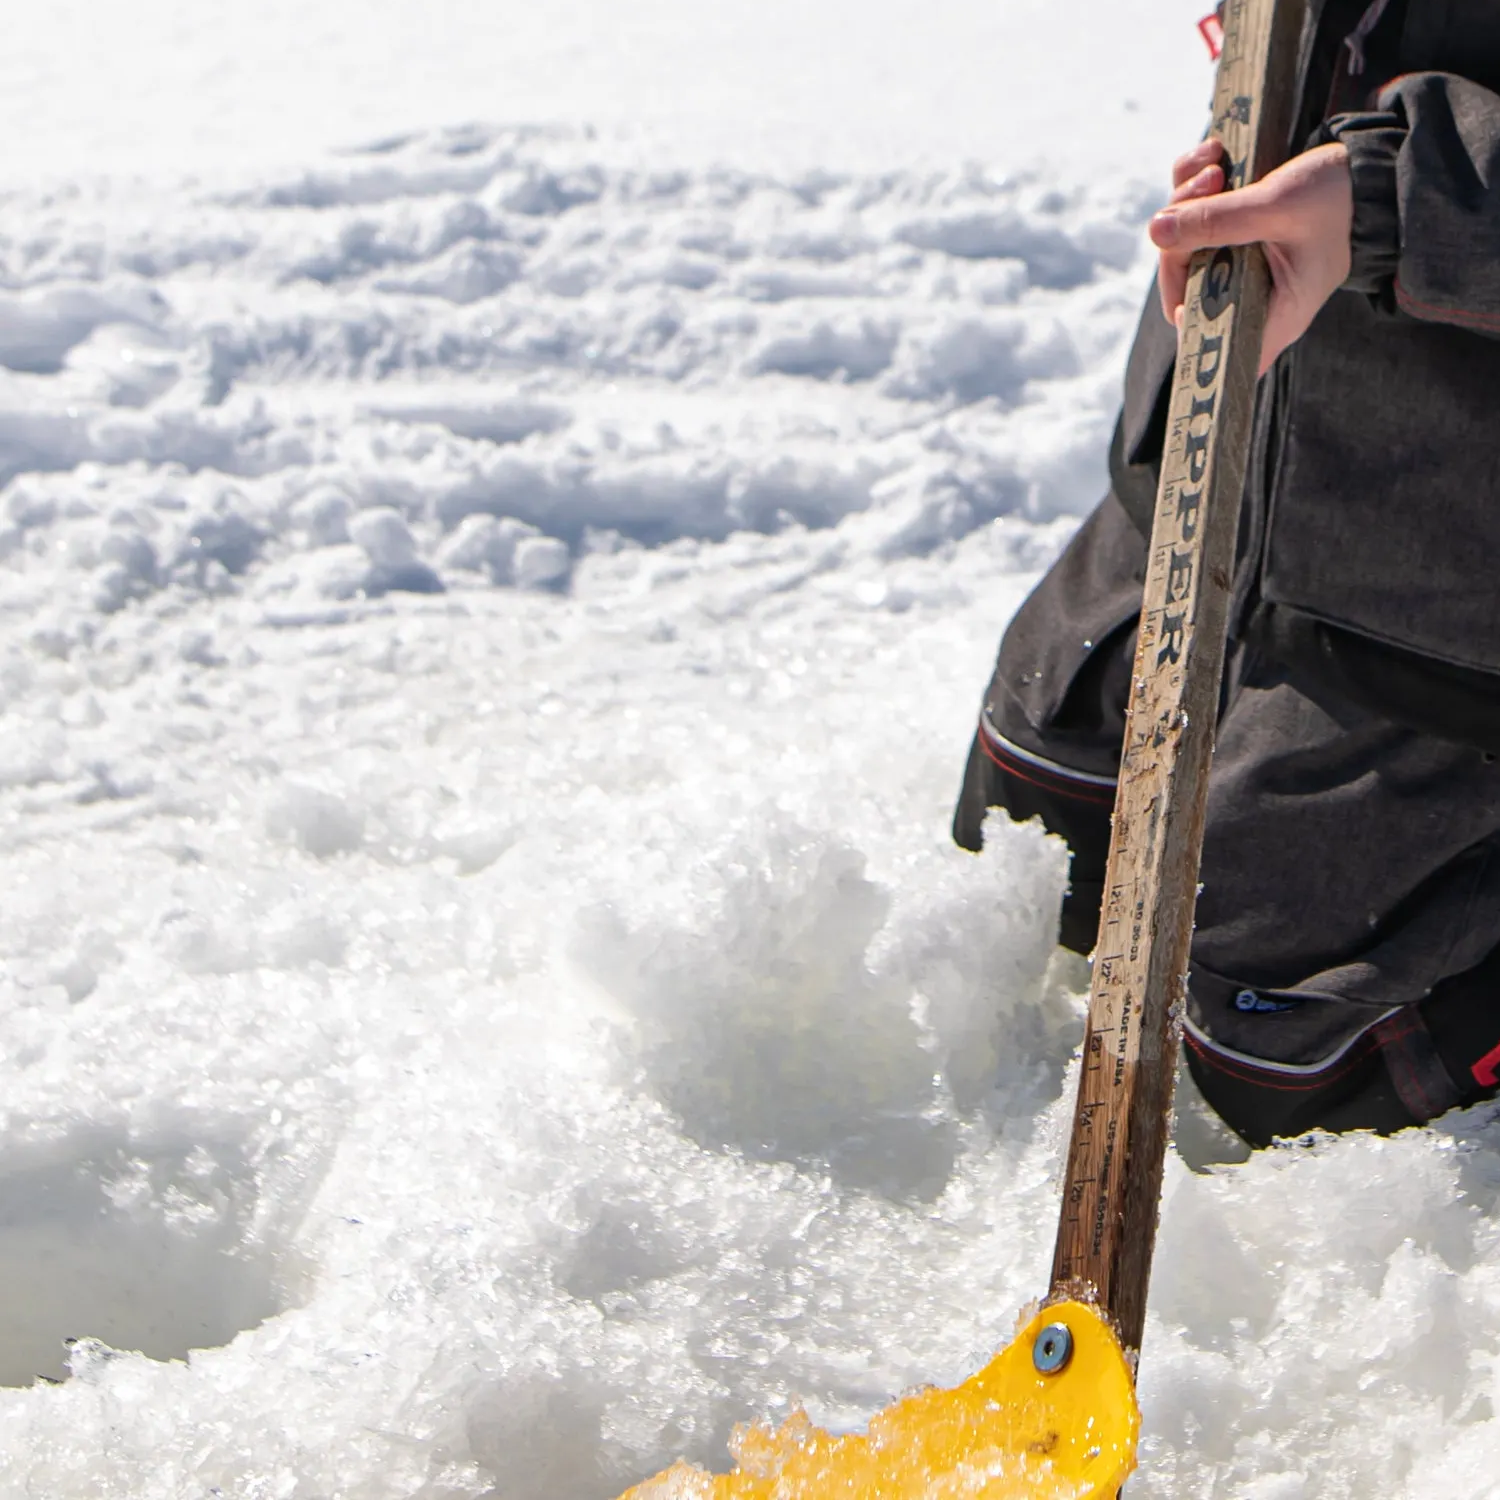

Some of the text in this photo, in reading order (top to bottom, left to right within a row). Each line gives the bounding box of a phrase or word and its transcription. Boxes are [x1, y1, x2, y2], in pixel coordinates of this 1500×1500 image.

[1157, 333, 1225, 668] DIPPER
[1118, 1037, 1128, 1053] IN
[1113, 1058, 1125, 1087] USA
